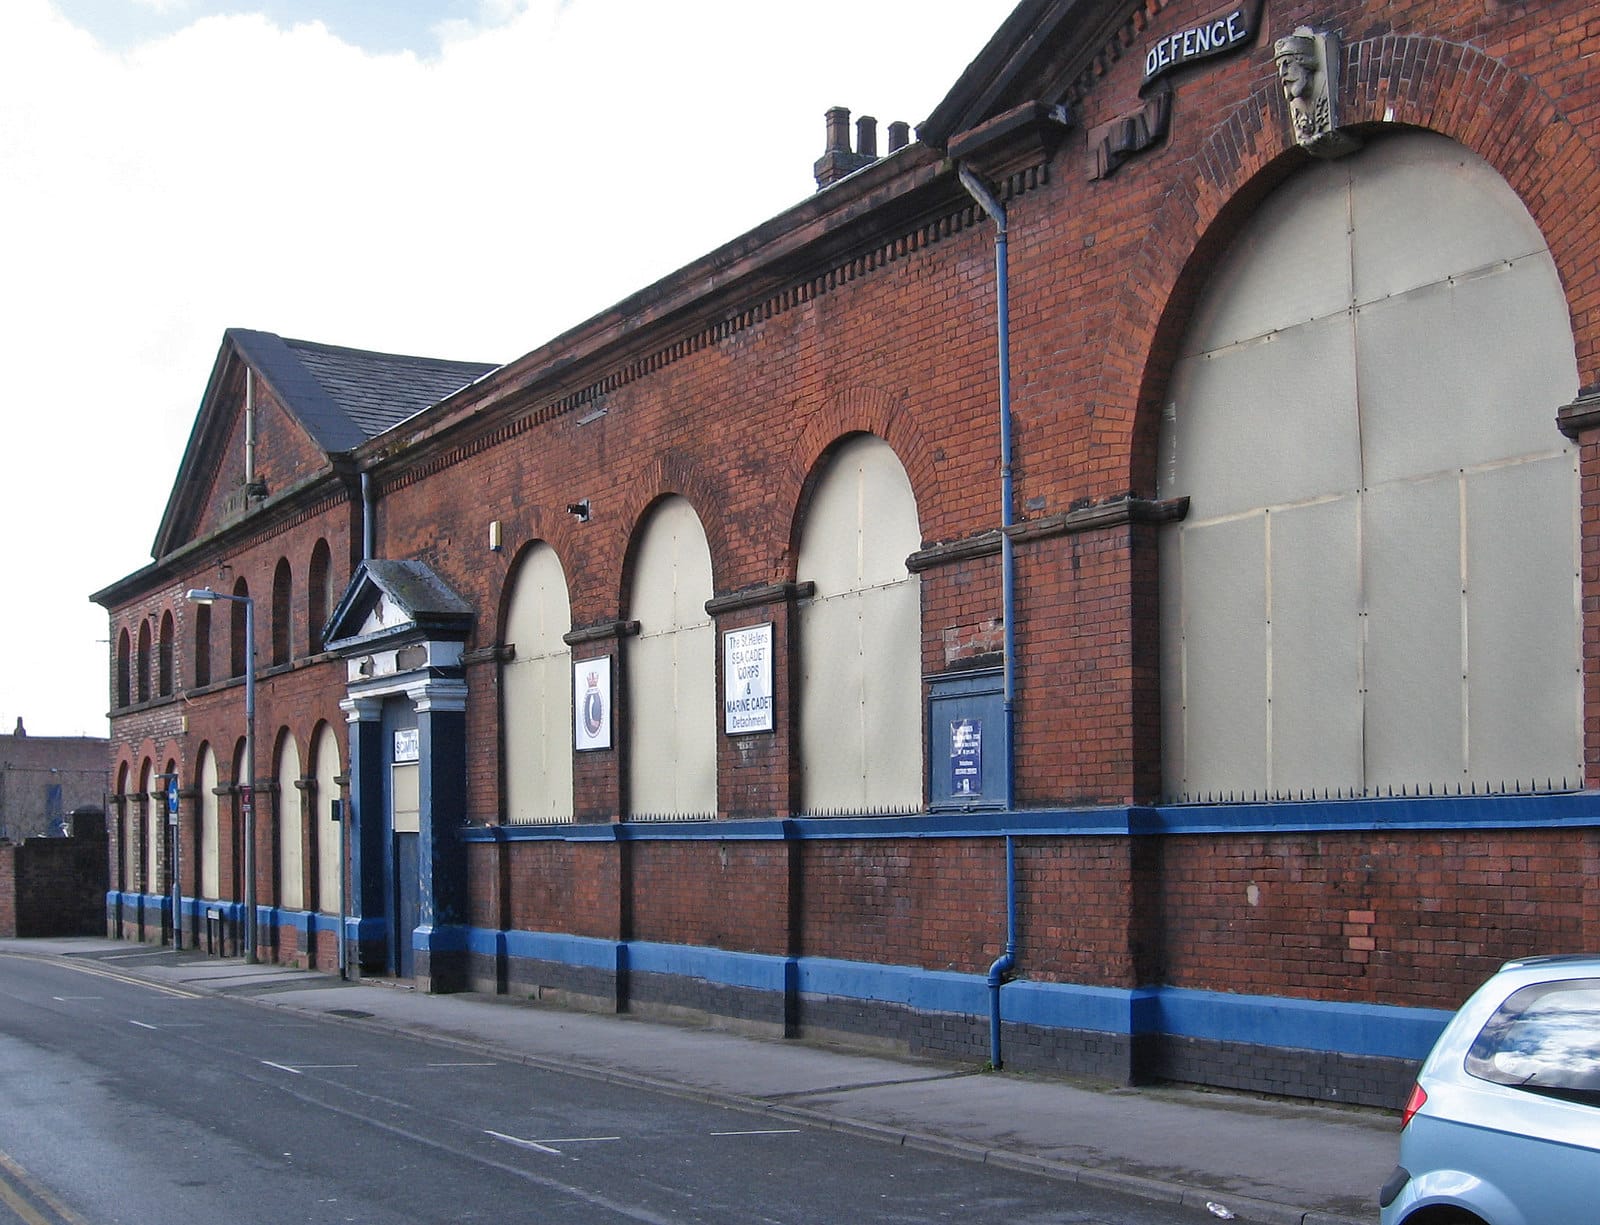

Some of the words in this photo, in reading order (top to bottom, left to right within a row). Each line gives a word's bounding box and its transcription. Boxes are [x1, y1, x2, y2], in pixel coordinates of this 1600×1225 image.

[1145, 11, 1247, 76] DEFENCE
[729, 636, 740, 649] The
[732, 651, 744, 664] SEA
[745, 648, 765, 663] CADET
[737, 665, 759, 680] CORPS
[746, 682, 751, 695] &
[727, 699, 750, 713] MARINE
[751, 696, 772, 711] CADET
[732, 713, 767, 729] Detachment
